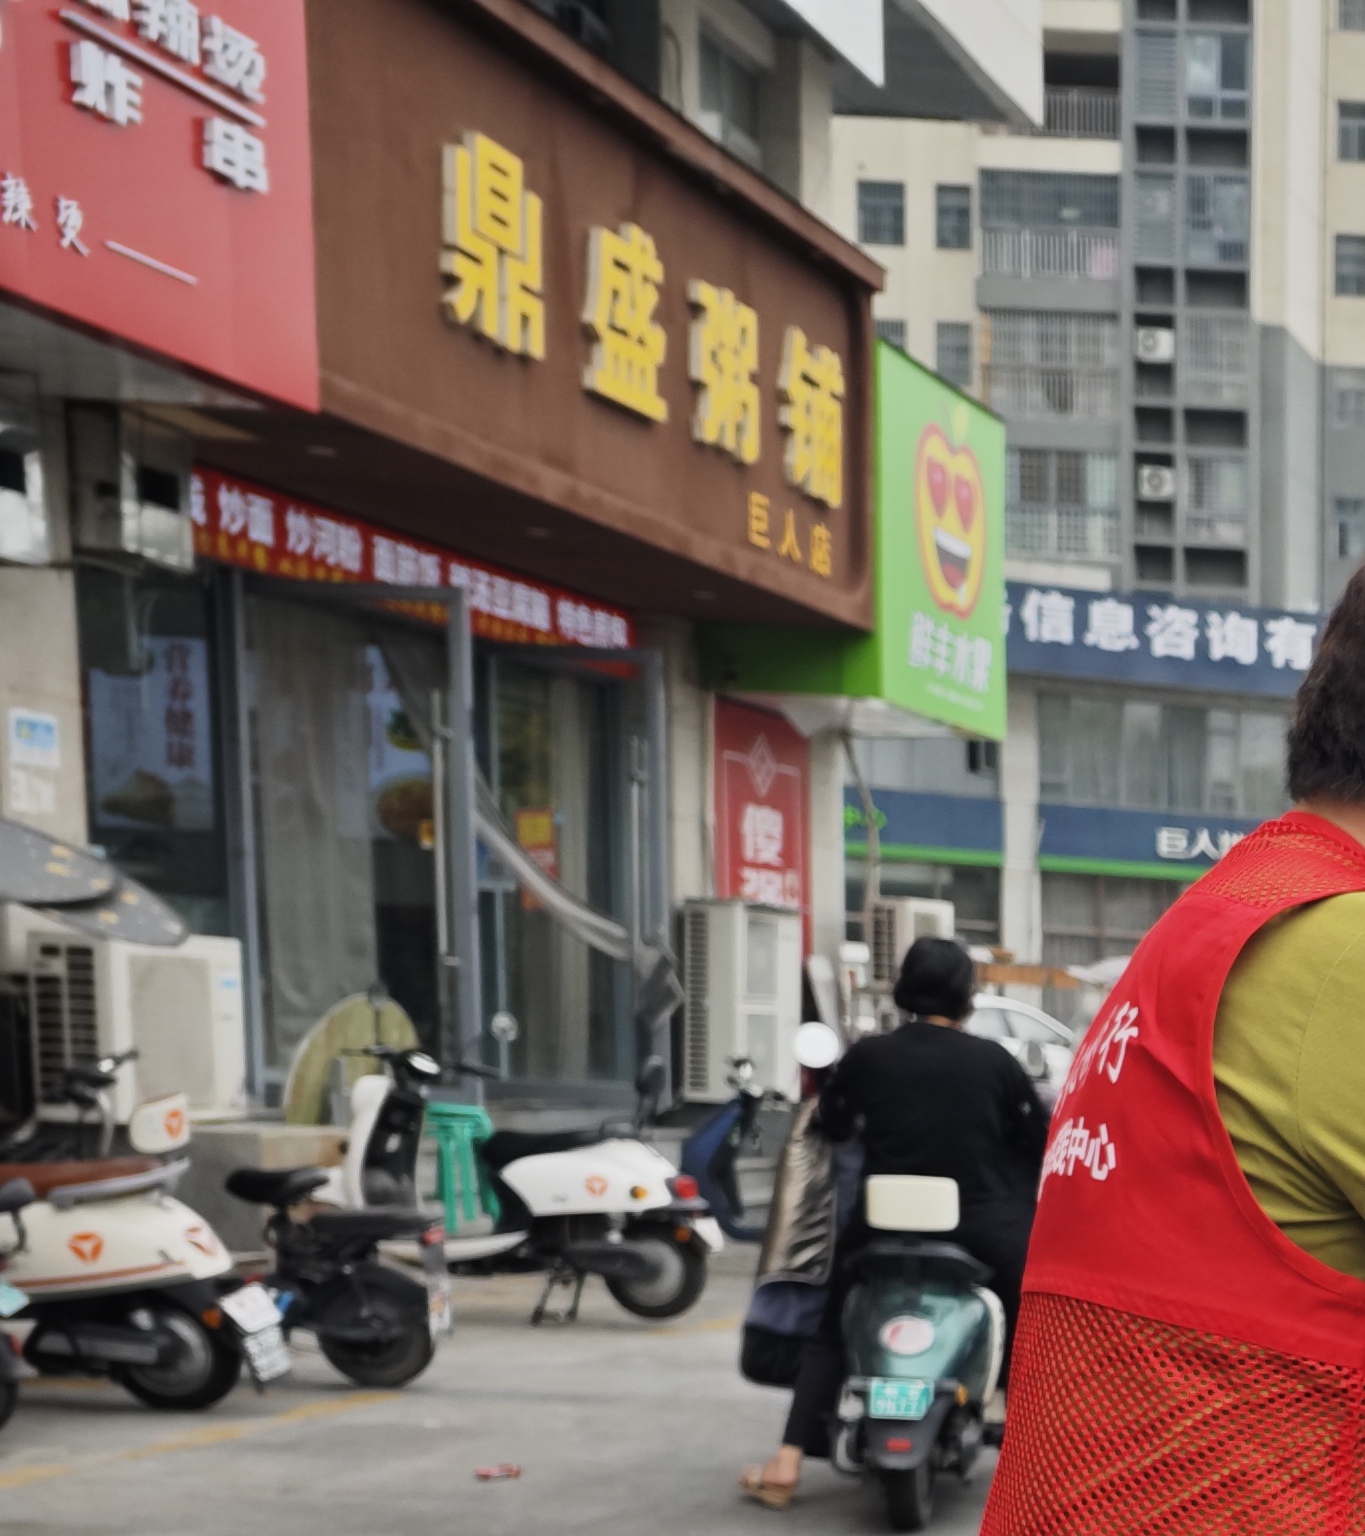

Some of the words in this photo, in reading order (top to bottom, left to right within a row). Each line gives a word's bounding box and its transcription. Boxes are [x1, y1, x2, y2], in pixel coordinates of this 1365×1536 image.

[70, 40, 268, 194] 炸串
[440, 130, 845, 509] 鼎盛粥铺
[747, 491, 833, 577] 巨人店
[906, 610, 992, 693] 鲜丰水果
[1000, 588, 1317, 670] 信息咨询有
